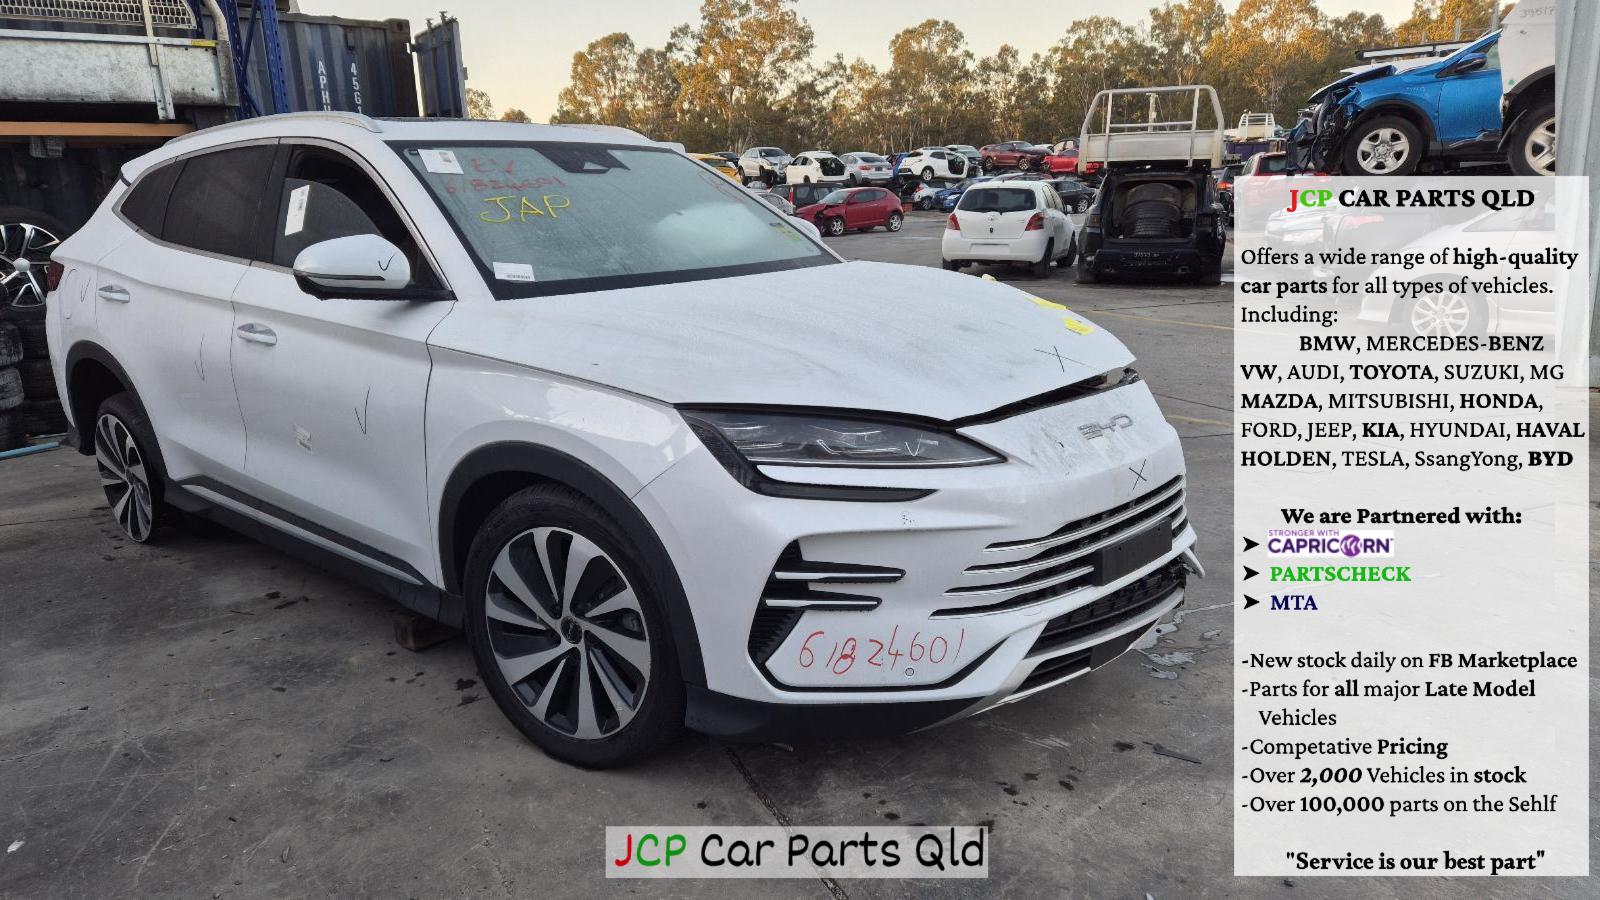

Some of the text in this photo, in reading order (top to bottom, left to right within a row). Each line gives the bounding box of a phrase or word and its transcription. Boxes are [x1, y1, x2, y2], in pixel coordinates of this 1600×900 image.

[479, 194, 570, 223] JAP
[1078, 413, 1133, 440] BYD
[800, 624, 965, 675] 61824601
